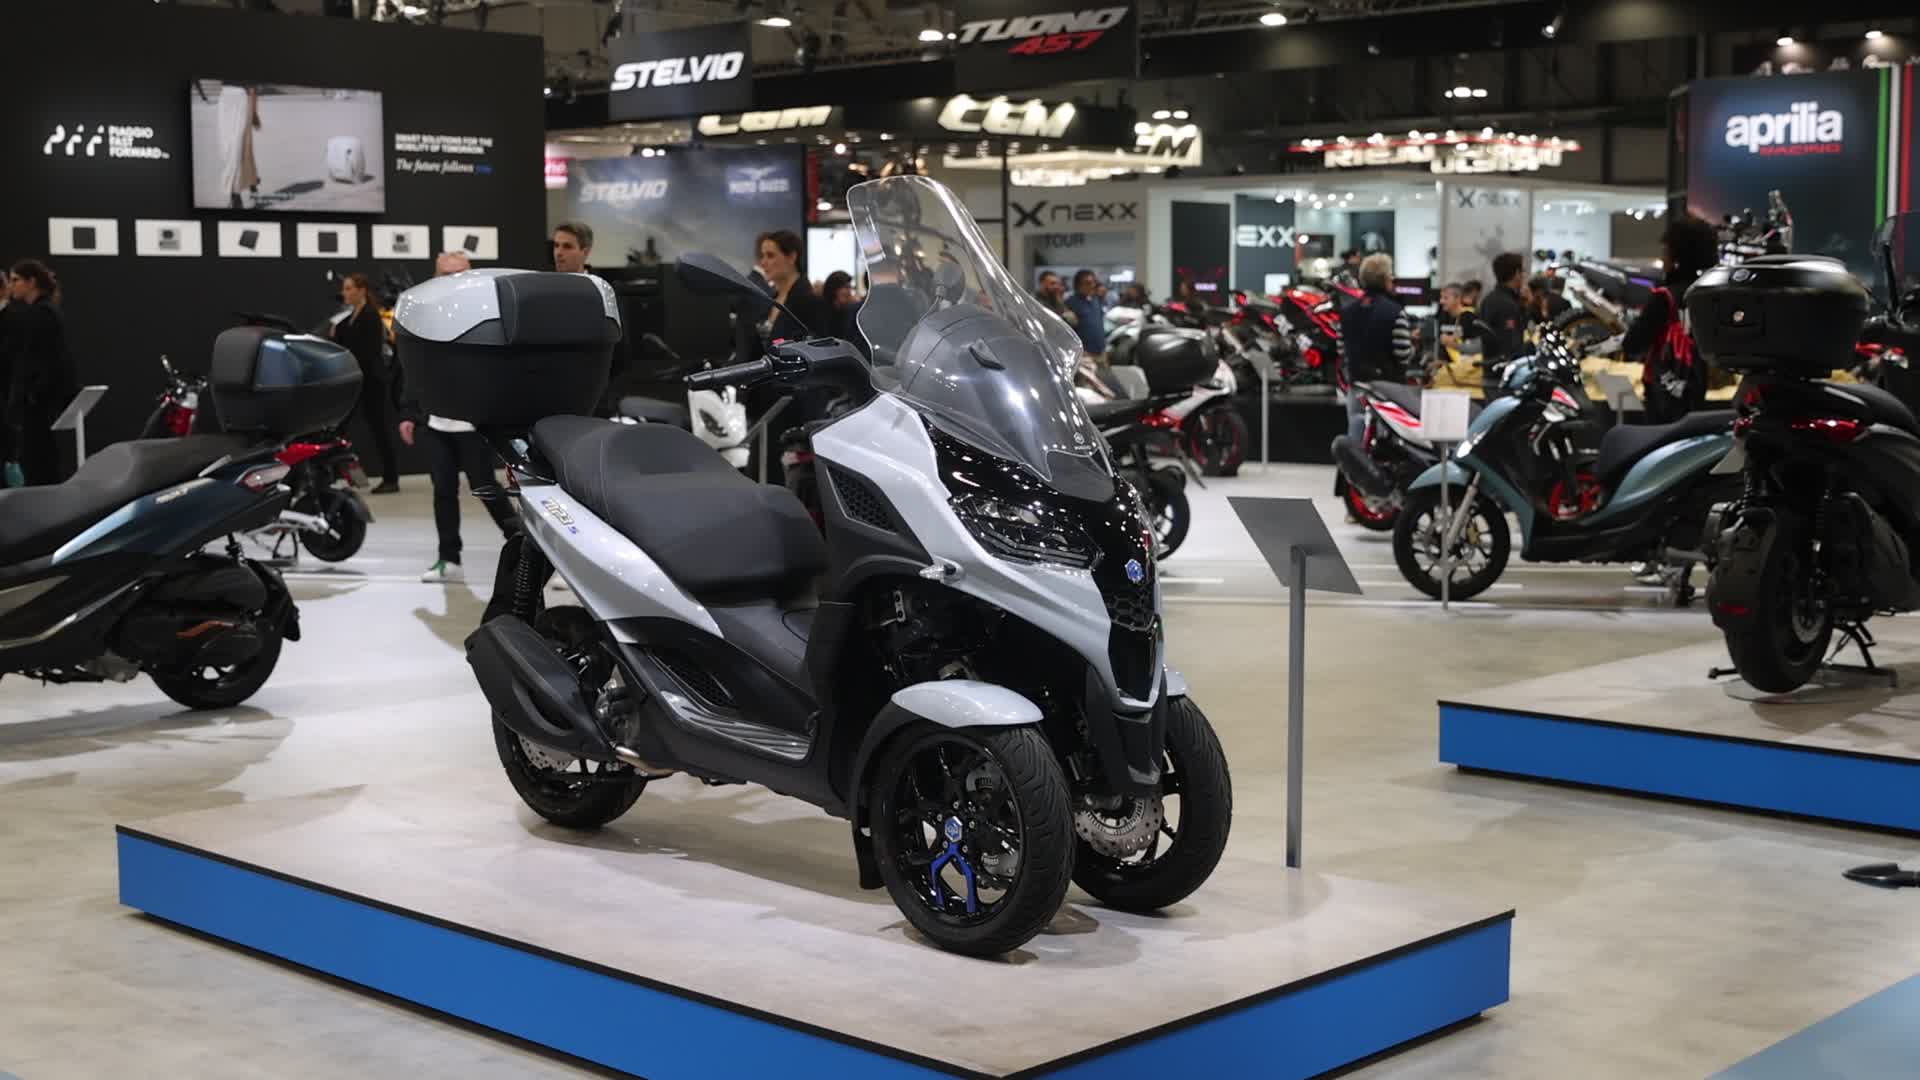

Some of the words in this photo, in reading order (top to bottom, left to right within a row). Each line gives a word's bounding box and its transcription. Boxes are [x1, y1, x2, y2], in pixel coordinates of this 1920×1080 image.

[959, 7, 1129, 44] TUONO
[1007, 30, 1105, 56] 457
[610, 52, 744, 91] STELVIO
[1725, 101, 1843, 153] aprilia
